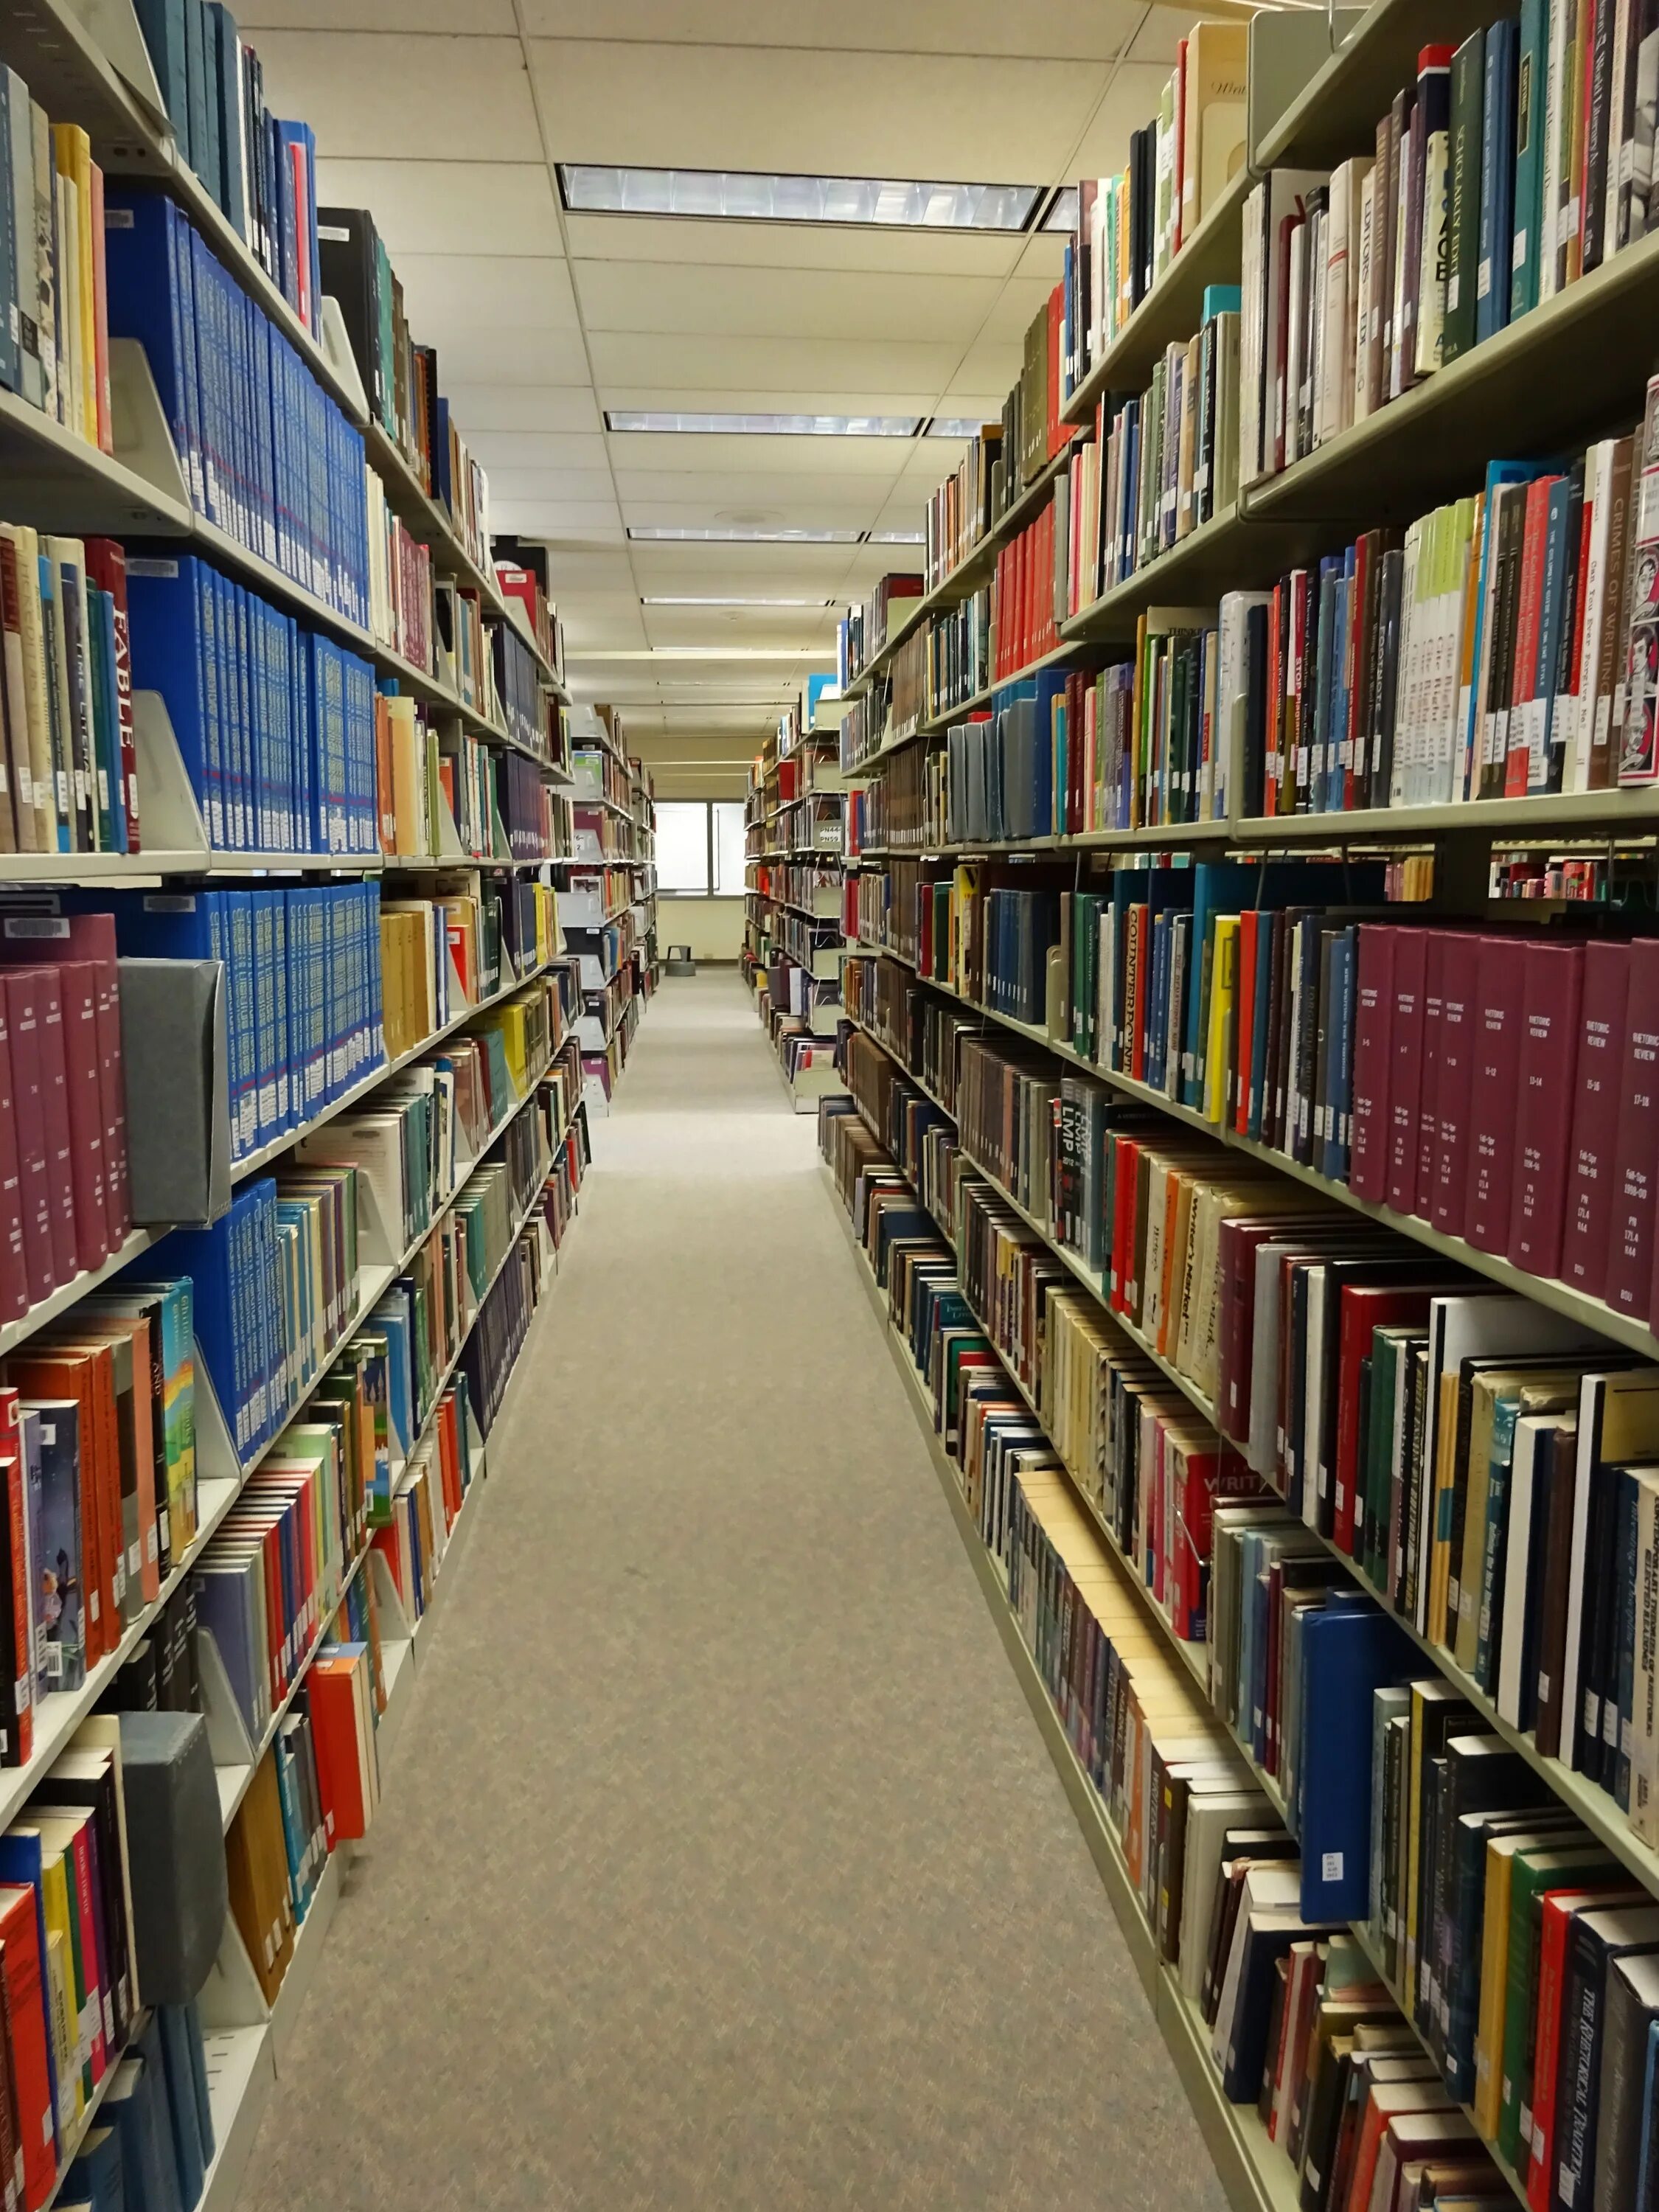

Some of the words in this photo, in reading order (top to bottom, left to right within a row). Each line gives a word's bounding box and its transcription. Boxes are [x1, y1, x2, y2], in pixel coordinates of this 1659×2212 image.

[1453, 125, 1467, 228] SCHOLARLY
[1362, 198, 1372, 285] EDITORS
[1609, 498, 1624, 573] CRIMES
[1545, 548, 1555, 587] COLUMBIA
[1589, 560, 1599, 583] Can
[1544, 590, 1552, 613] GUIDE
[1587, 589, 1597, 612] You
[1607, 580, 1619, 608] OF
[1543, 618, 1550, 628] TO
[1585, 618, 1595, 647] Ever
[1600, 612, 1616, 695] WRITING
[114, 608, 133, 748] FABLE
[1295, 657, 1303, 689] STOP
[1376, 625, 1386, 713] FOOTNOTE
[1539, 663, 1547, 686] STYLE
[1580, 653, 1593, 703] Forgive
[1124, 909, 1138, 1071] COUNTERPOINT
[1587, 1020, 1610, 1034] RHETORIC
[1587, 1035, 1606, 1048] REVIEW
[1634, 1048, 1655, 1060] REVIEW
[1587, 1079, 1600, 1091] 15-16
[1634, 1094, 1649, 1107] 17-18
[1062, 1106, 1074, 1152] LMP
[1624, 1183, 1646, 1199] 1998-00
[1626, 1169, 1646, 1184] Fall-Spr
[1581, 1194, 1589, 1205] PN
[1187, 1197, 1200, 1262] Writer's
[1624, 1230, 1638, 1243] 171.4
[1629, 1216, 1638, 1228] PN
[1624, 1245, 1636, 1257] R44
[1181, 1262, 1194, 1320] Market
[1486, 1521, 1498, 1554] Defining
[1582, 1987, 1596, 2022] THE
[1575, 2017, 1594, 2106] RHETORICAL
[1570, 2106, 1588, 2185] TRADITION
